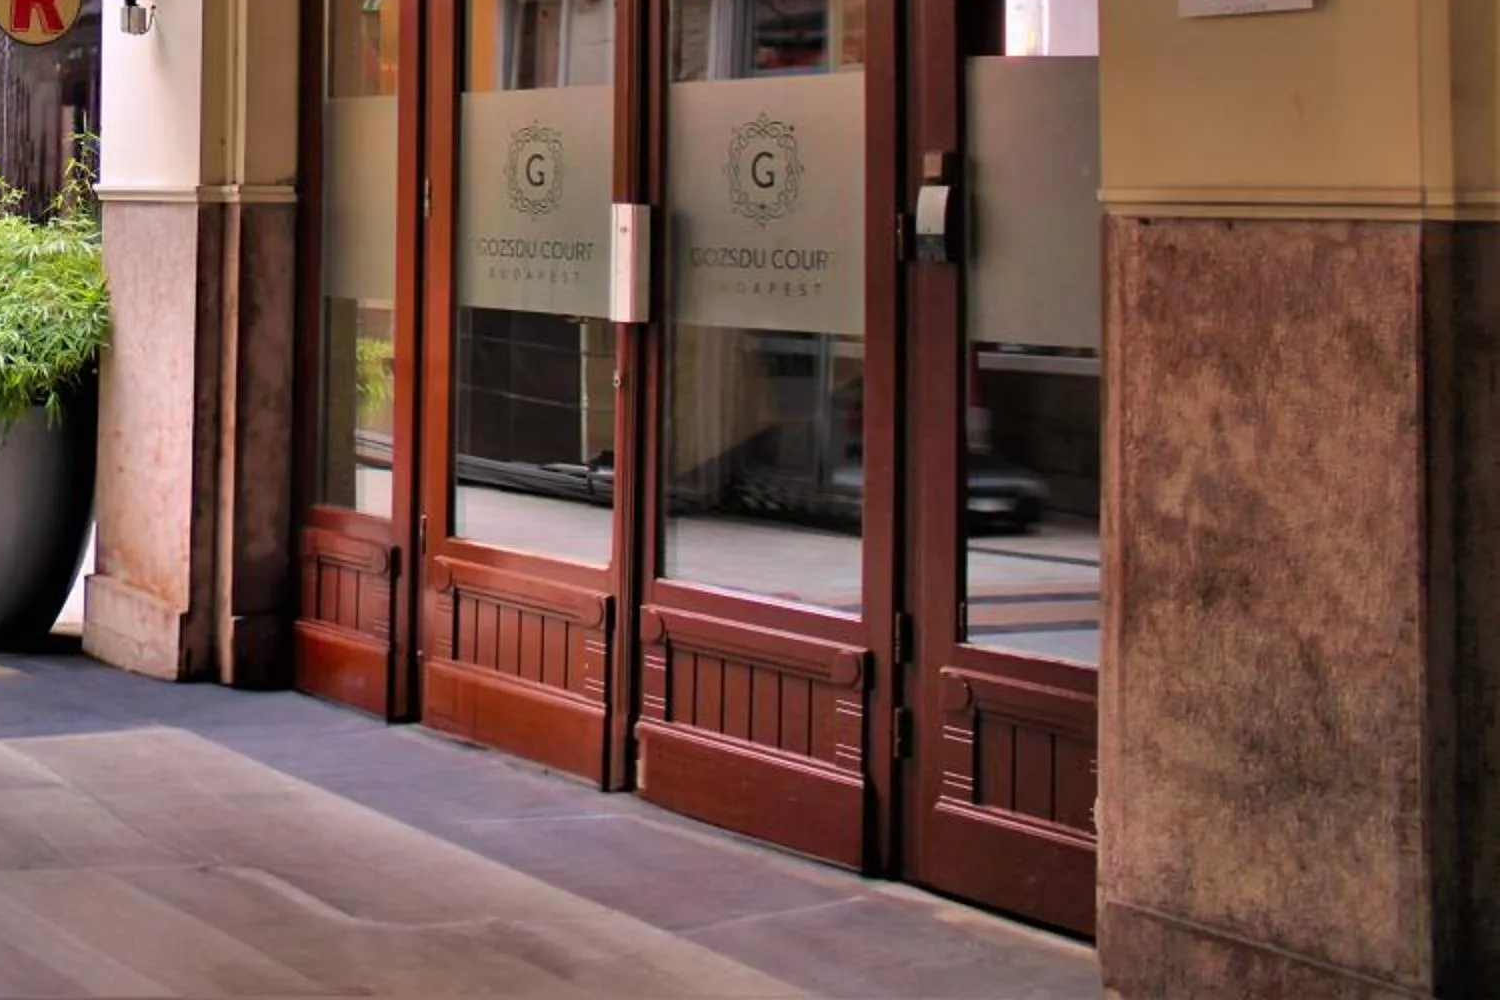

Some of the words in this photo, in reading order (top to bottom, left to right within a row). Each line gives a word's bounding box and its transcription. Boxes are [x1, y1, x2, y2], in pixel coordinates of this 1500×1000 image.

[526, 154, 545, 187] G
[751, 151, 775, 189] G
[541, 240, 594, 262] COURT
[706, 278, 823, 298] DAPEST
